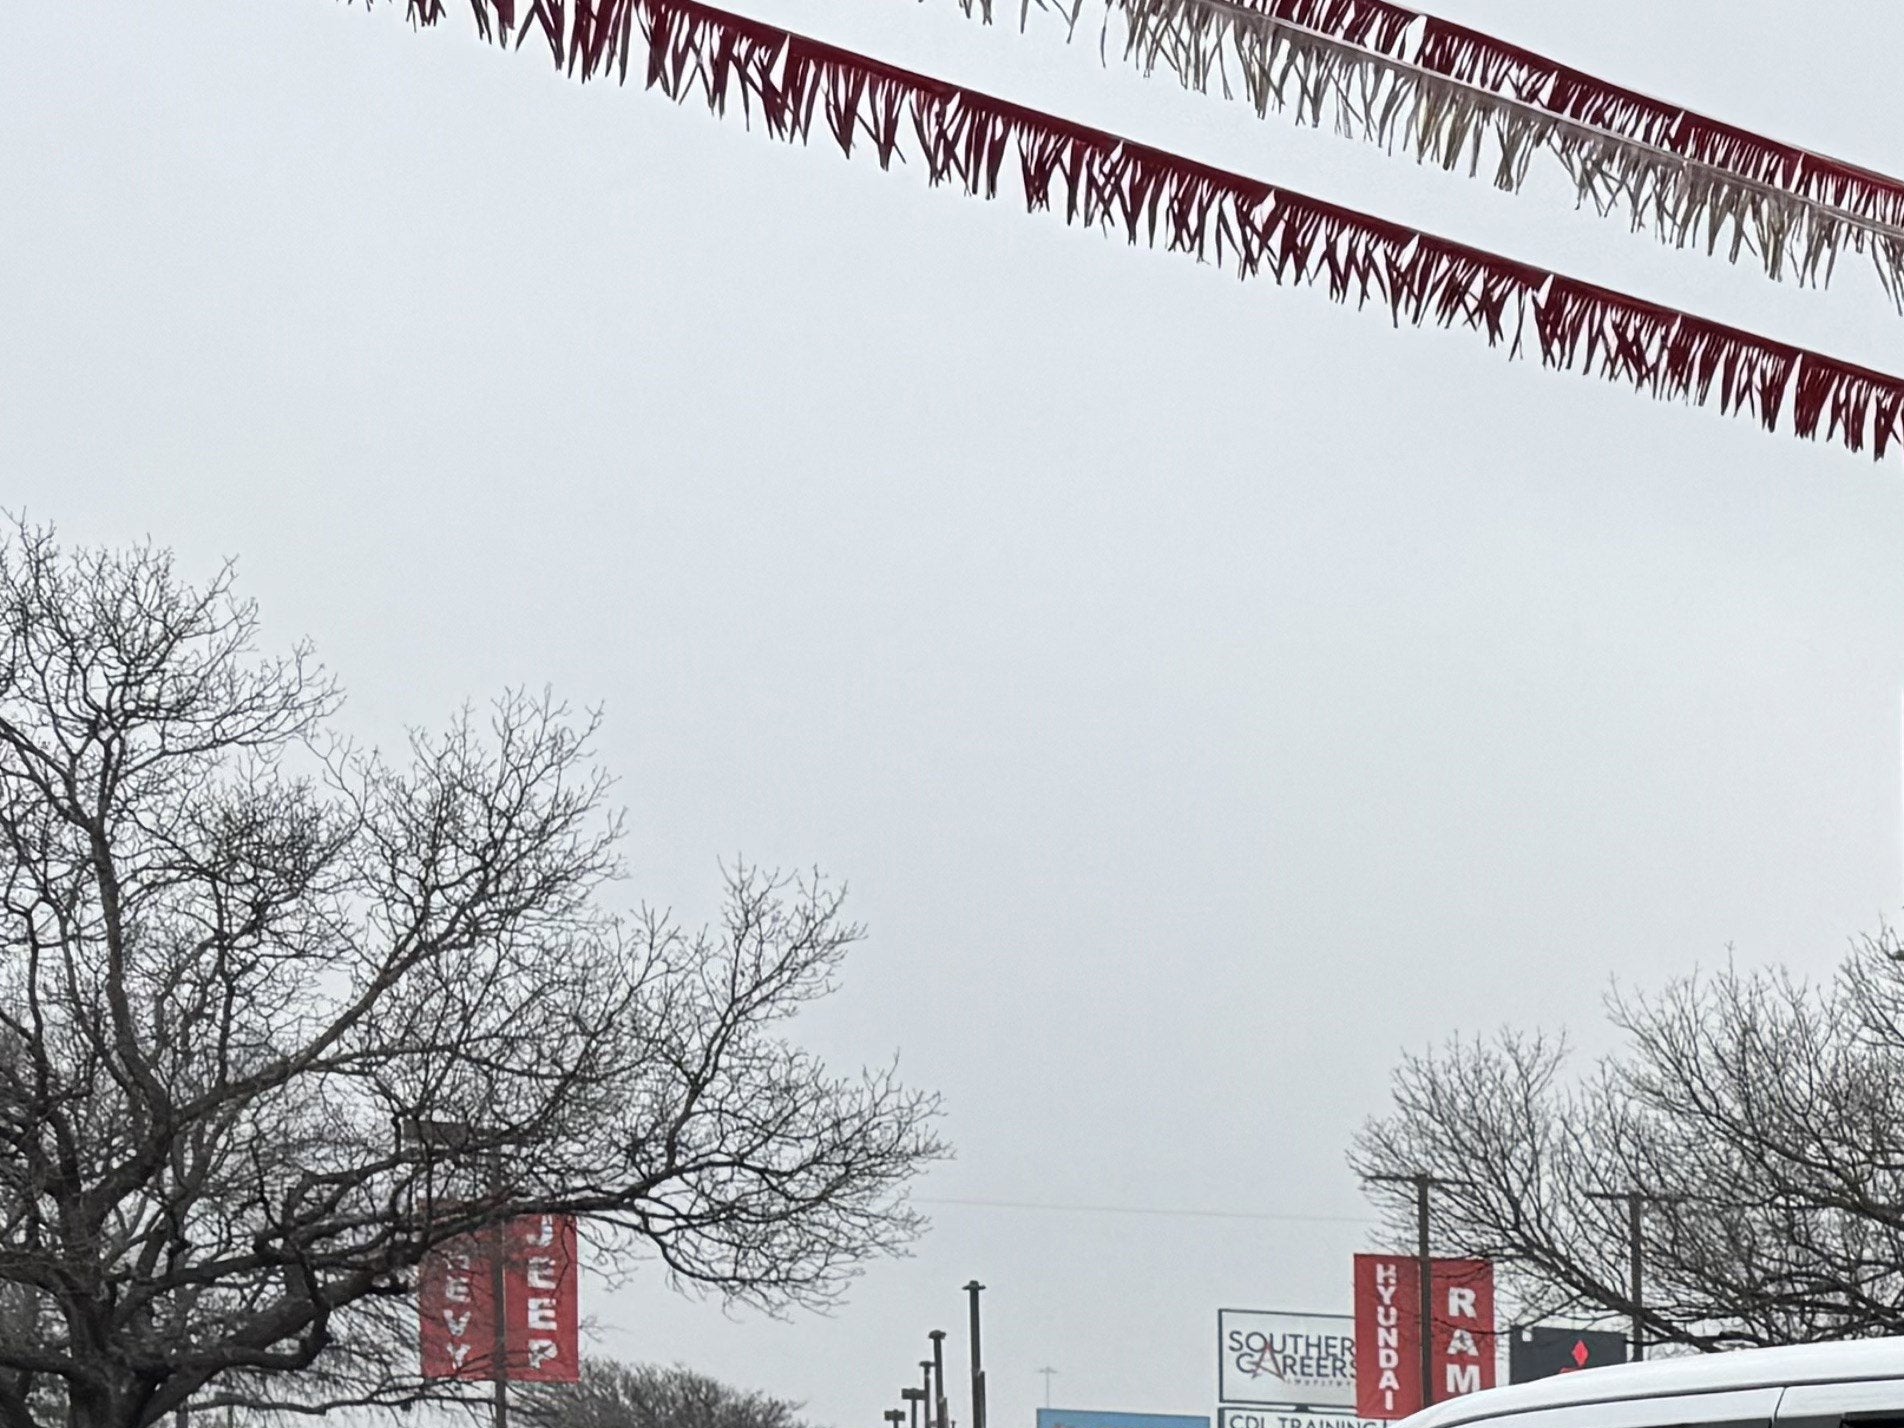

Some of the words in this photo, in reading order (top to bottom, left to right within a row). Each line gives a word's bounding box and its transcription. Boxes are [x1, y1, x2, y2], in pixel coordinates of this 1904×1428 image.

[526, 1214, 558, 1370] JEEP
[1228, 1330, 1355, 1358] SOUTHER
[1376, 1263, 1399, 1411] HYUNDAI
[1446, 1287, 1481, 1394] RAM
